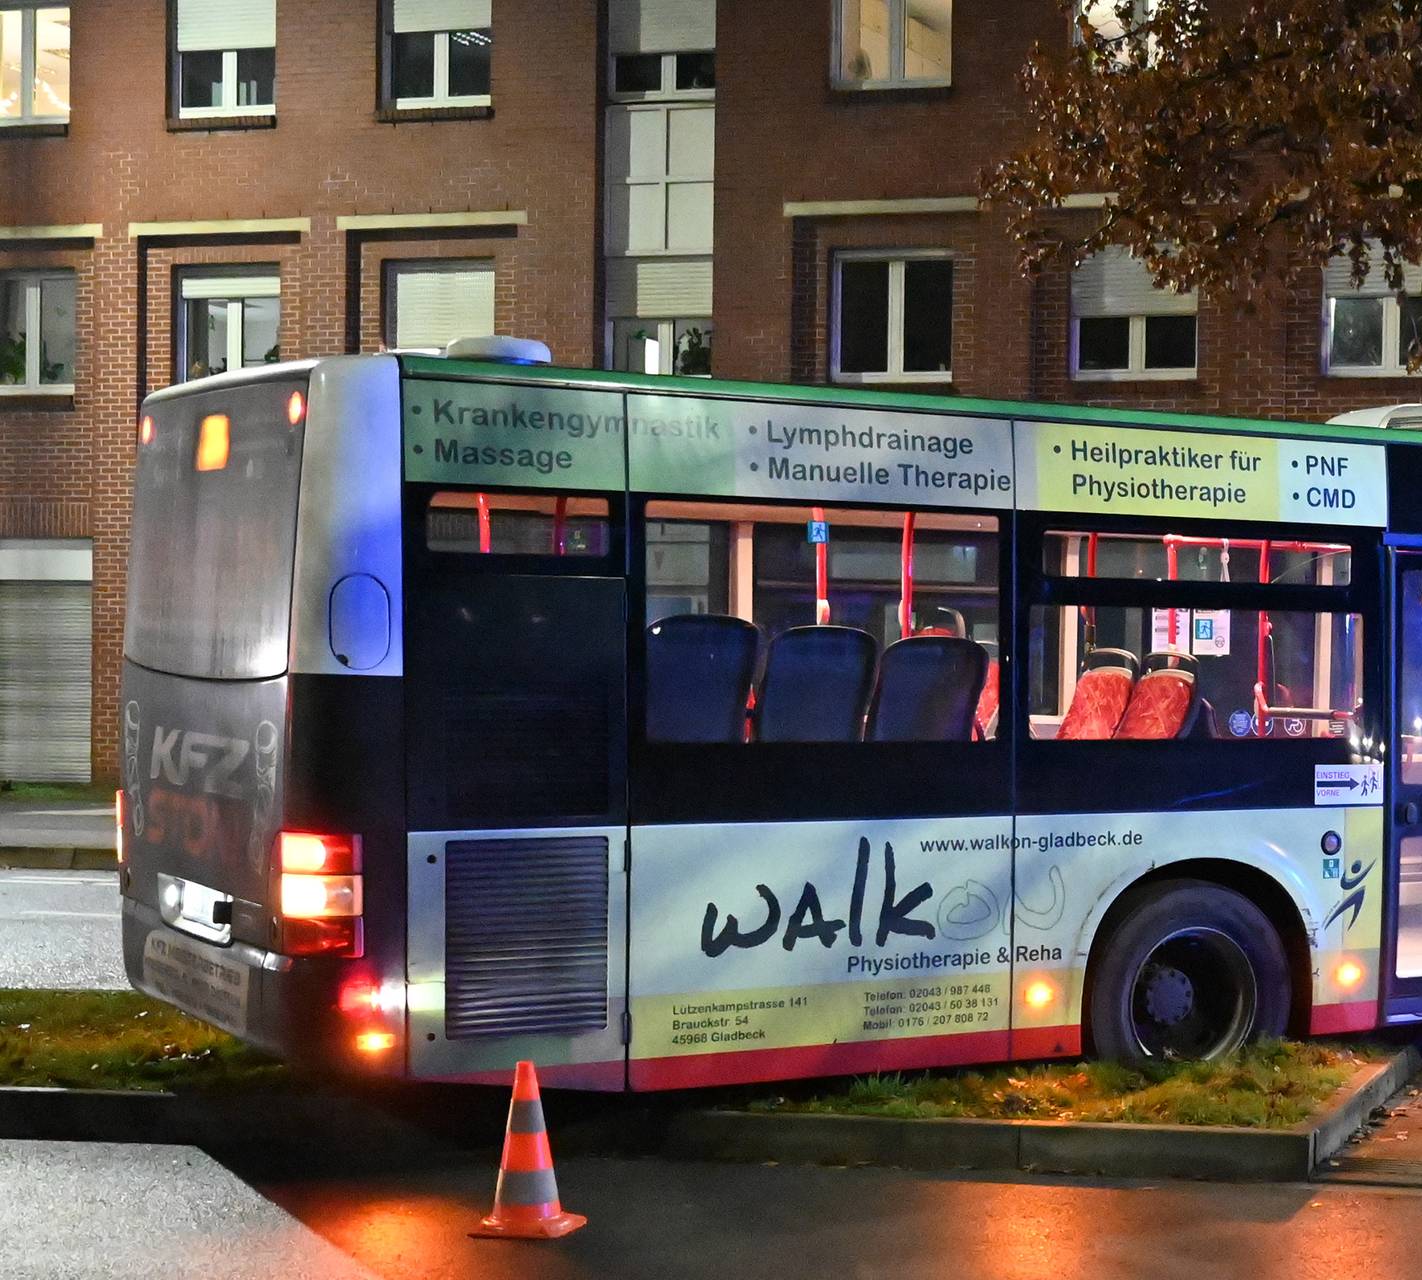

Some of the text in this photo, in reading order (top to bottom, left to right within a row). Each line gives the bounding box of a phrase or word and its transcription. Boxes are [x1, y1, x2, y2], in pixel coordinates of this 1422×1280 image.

[432, 399, 721, 440] Krankengymnastik
[766, 420, 974, 457] Lymphdrainage
[433, 440, 574, 472] Massage
[1071, 440, 1262, 472] Heilpraktiker für
[1305, 456, 1349, 477] PNF
[767, 462, 1012, 494] Manuelle Therapie
[1072, 474, 1247, 506] Physiotherapie
[1306, 487, 1356, 509] CMD
[151, 726, 251, 794] KFZ
[1316, 771, 1350, 779] EINSTIEG
[1316, 789, 1340, 797] VORNE
[920, 830, 1143, 854] www.walkon-gladbeck.de
[847, 944, 1062, 974] Physiotherapie & Reha
[789, 996, 808, 1008] 141
[909, 987, 941, 999] 02043
[909, 1002, 941, 1013] 02043
[965, 998, 978, 1009] 38
[982, 997, 999, 1007] 131
[735, 1015, 749, 1026] 54
[932, 1014, 952, 1025] 207
[976, 1011, 989, 1021] 72
[672, 1029, 766, 1045] 45968 Gladbeck
